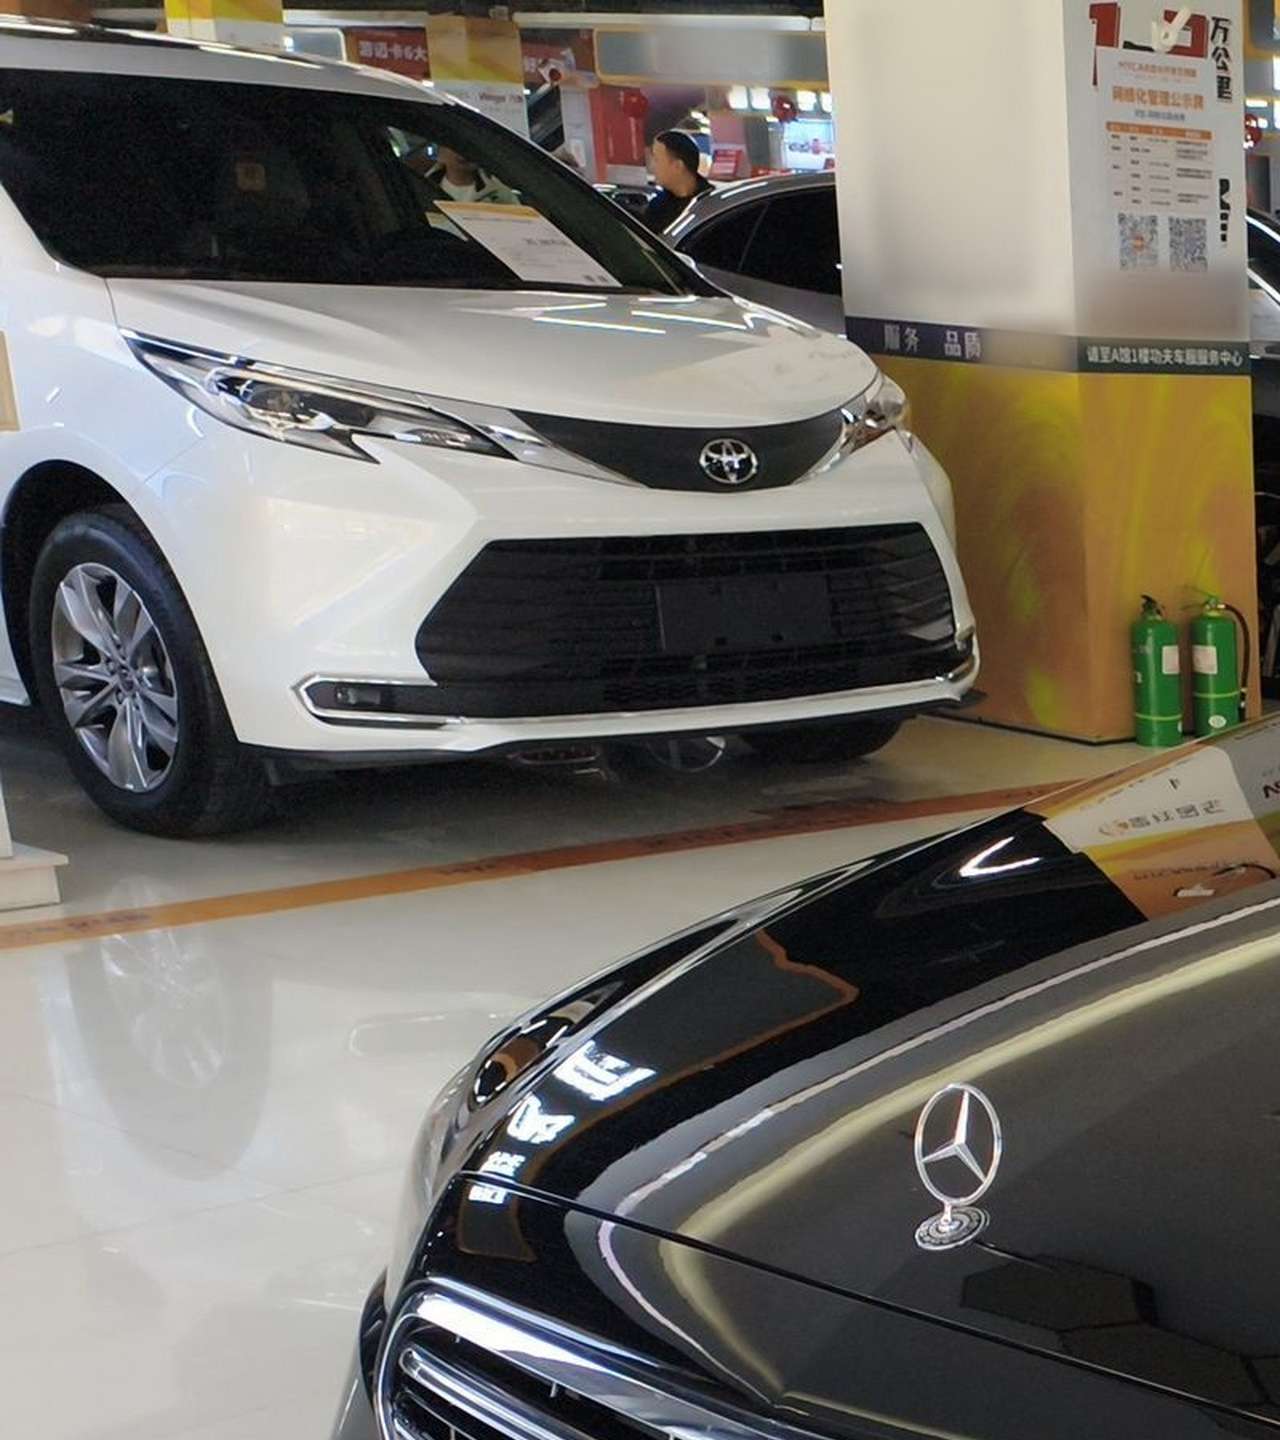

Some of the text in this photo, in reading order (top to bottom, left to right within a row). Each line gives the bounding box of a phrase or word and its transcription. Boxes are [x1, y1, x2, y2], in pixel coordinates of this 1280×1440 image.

[1210, 16, 1233, 100] 万公里
[884, 324, 980, 359] 服务 品质
